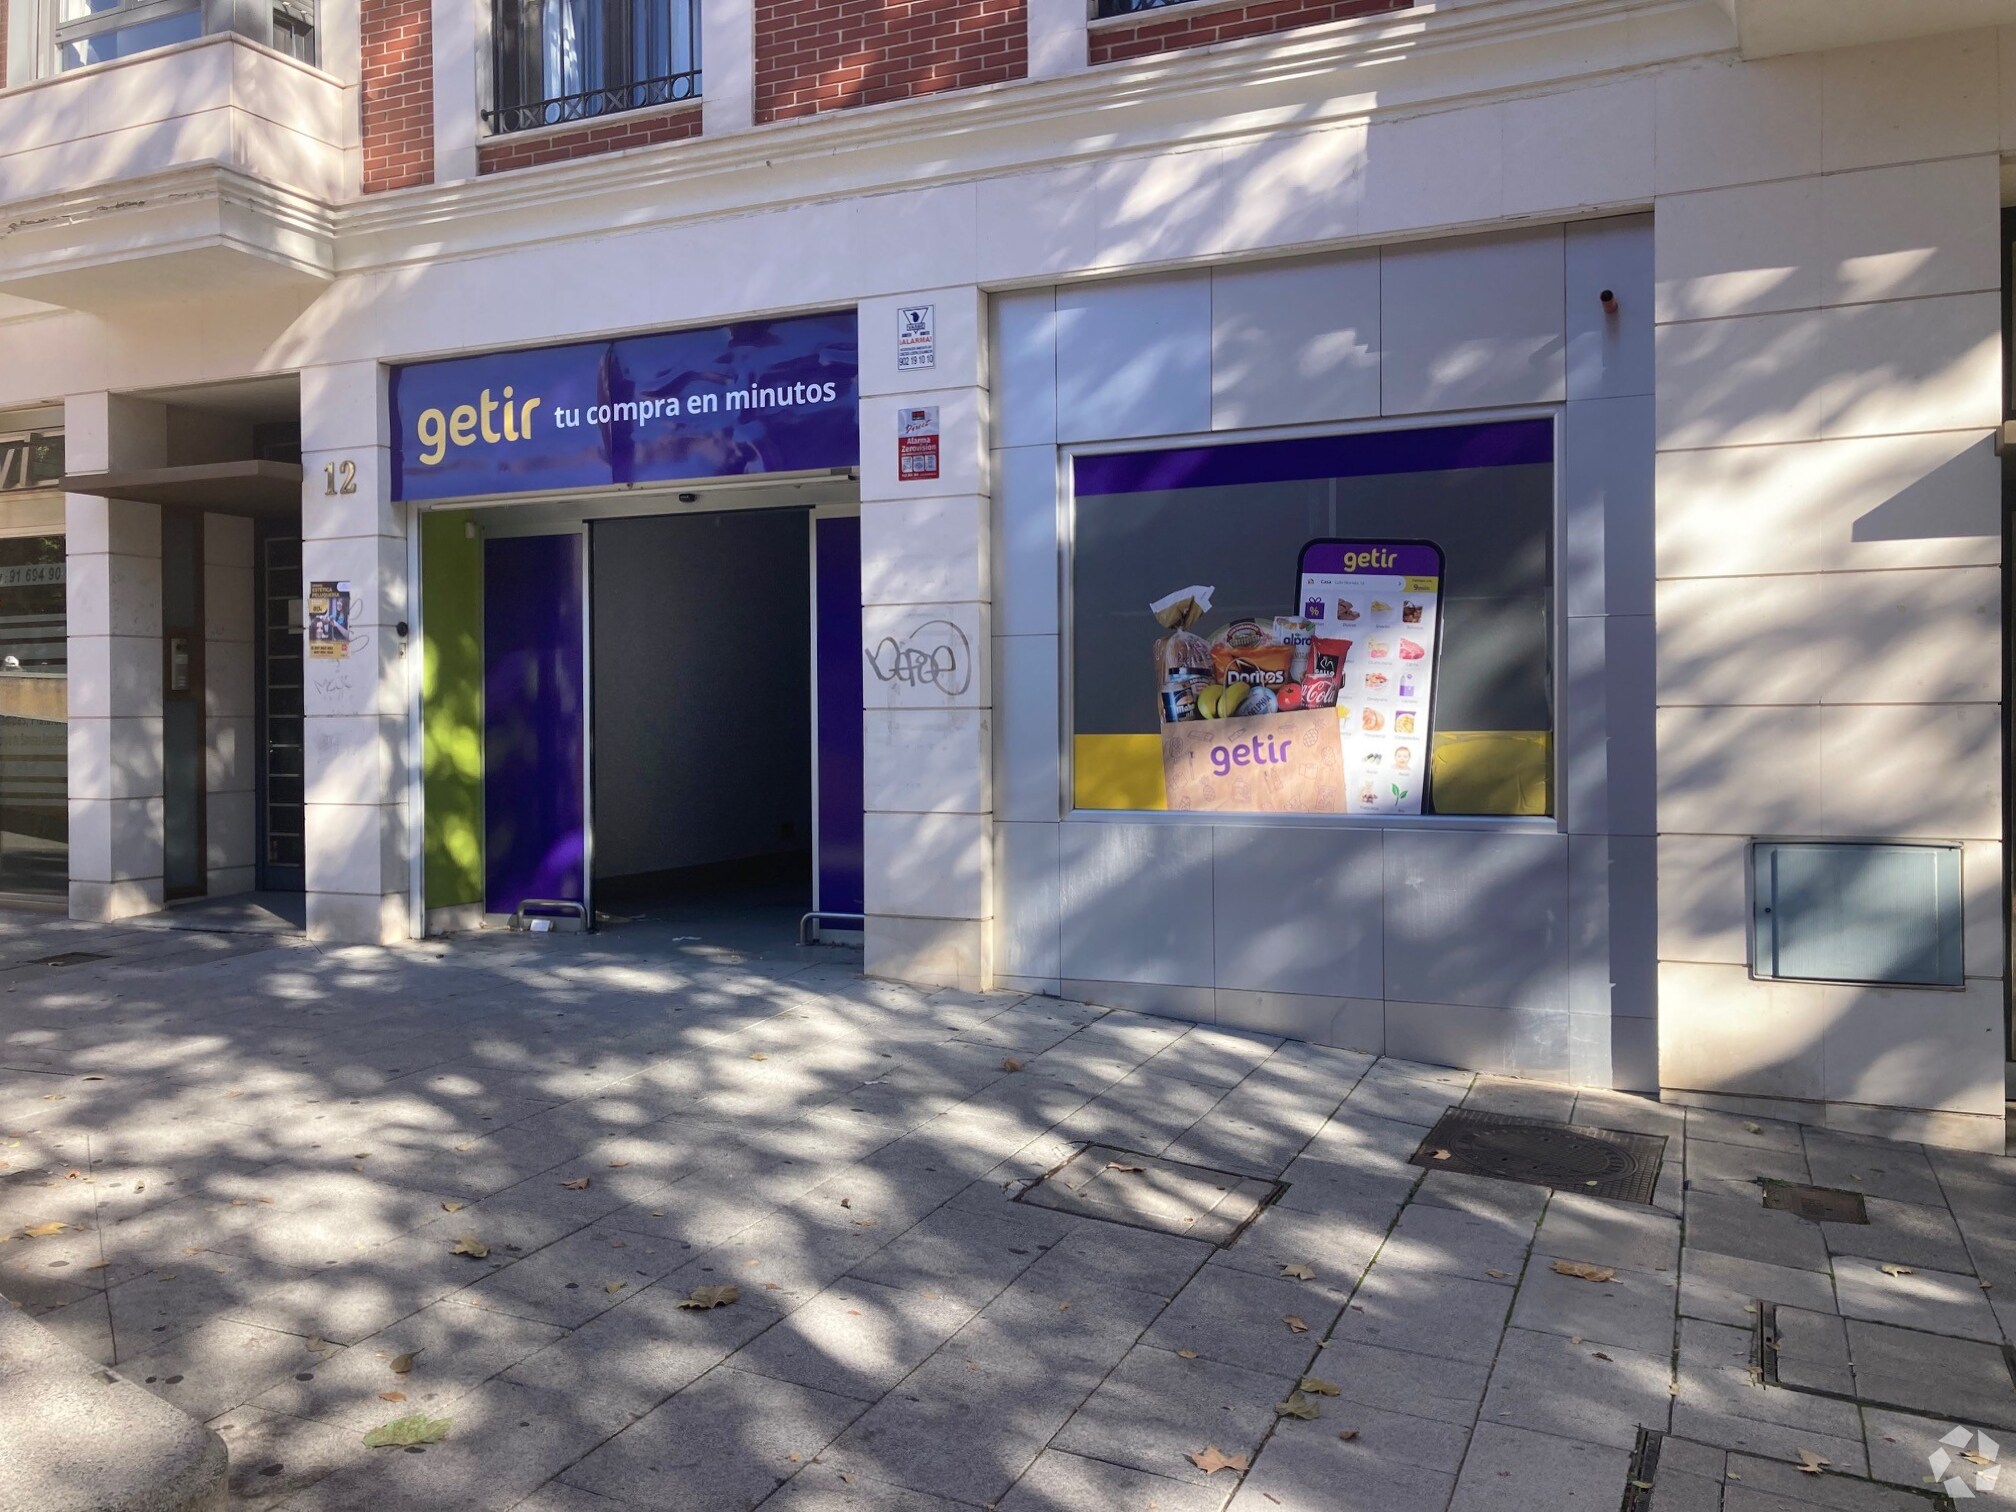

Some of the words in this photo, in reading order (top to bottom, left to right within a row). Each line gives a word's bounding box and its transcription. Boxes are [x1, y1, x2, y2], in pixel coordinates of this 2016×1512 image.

[418, 386, 541, 466] getir
[554, 406, 580, 429] tu
[586, 396, 680, 429] compra
[687, 394, 718, 414] en
[725, 380, 837, 412] minutos
[907, 437, 931, 445] Alarma
[324, 460, 357, 496] 12
[1343, 548, 1398, 572] getir
[1227, 670, 1284, 684] Doritos
[1210, 734, 1293, 777] getir
